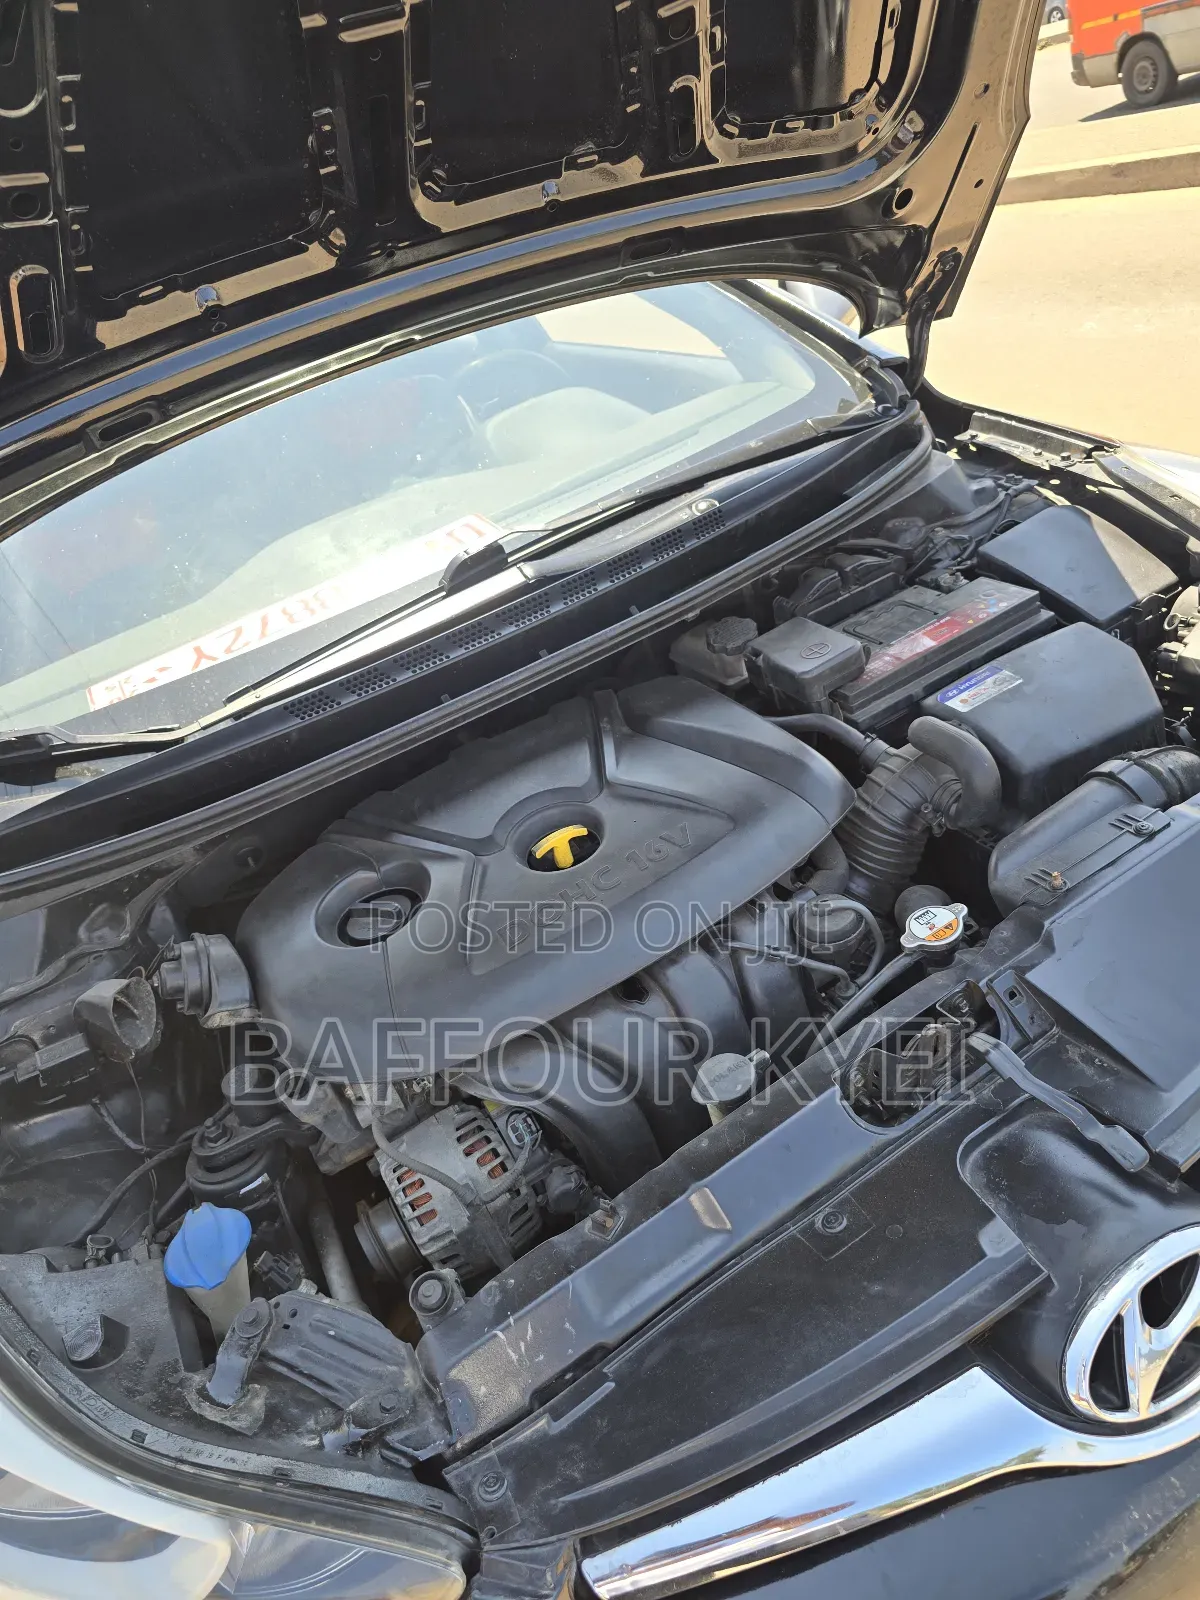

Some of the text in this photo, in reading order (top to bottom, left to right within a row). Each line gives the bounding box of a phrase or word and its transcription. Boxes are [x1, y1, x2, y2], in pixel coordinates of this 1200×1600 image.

[958, 671, 991, 690] HYUNDAI
[496, 821, 692, 951] DOHC 16V
